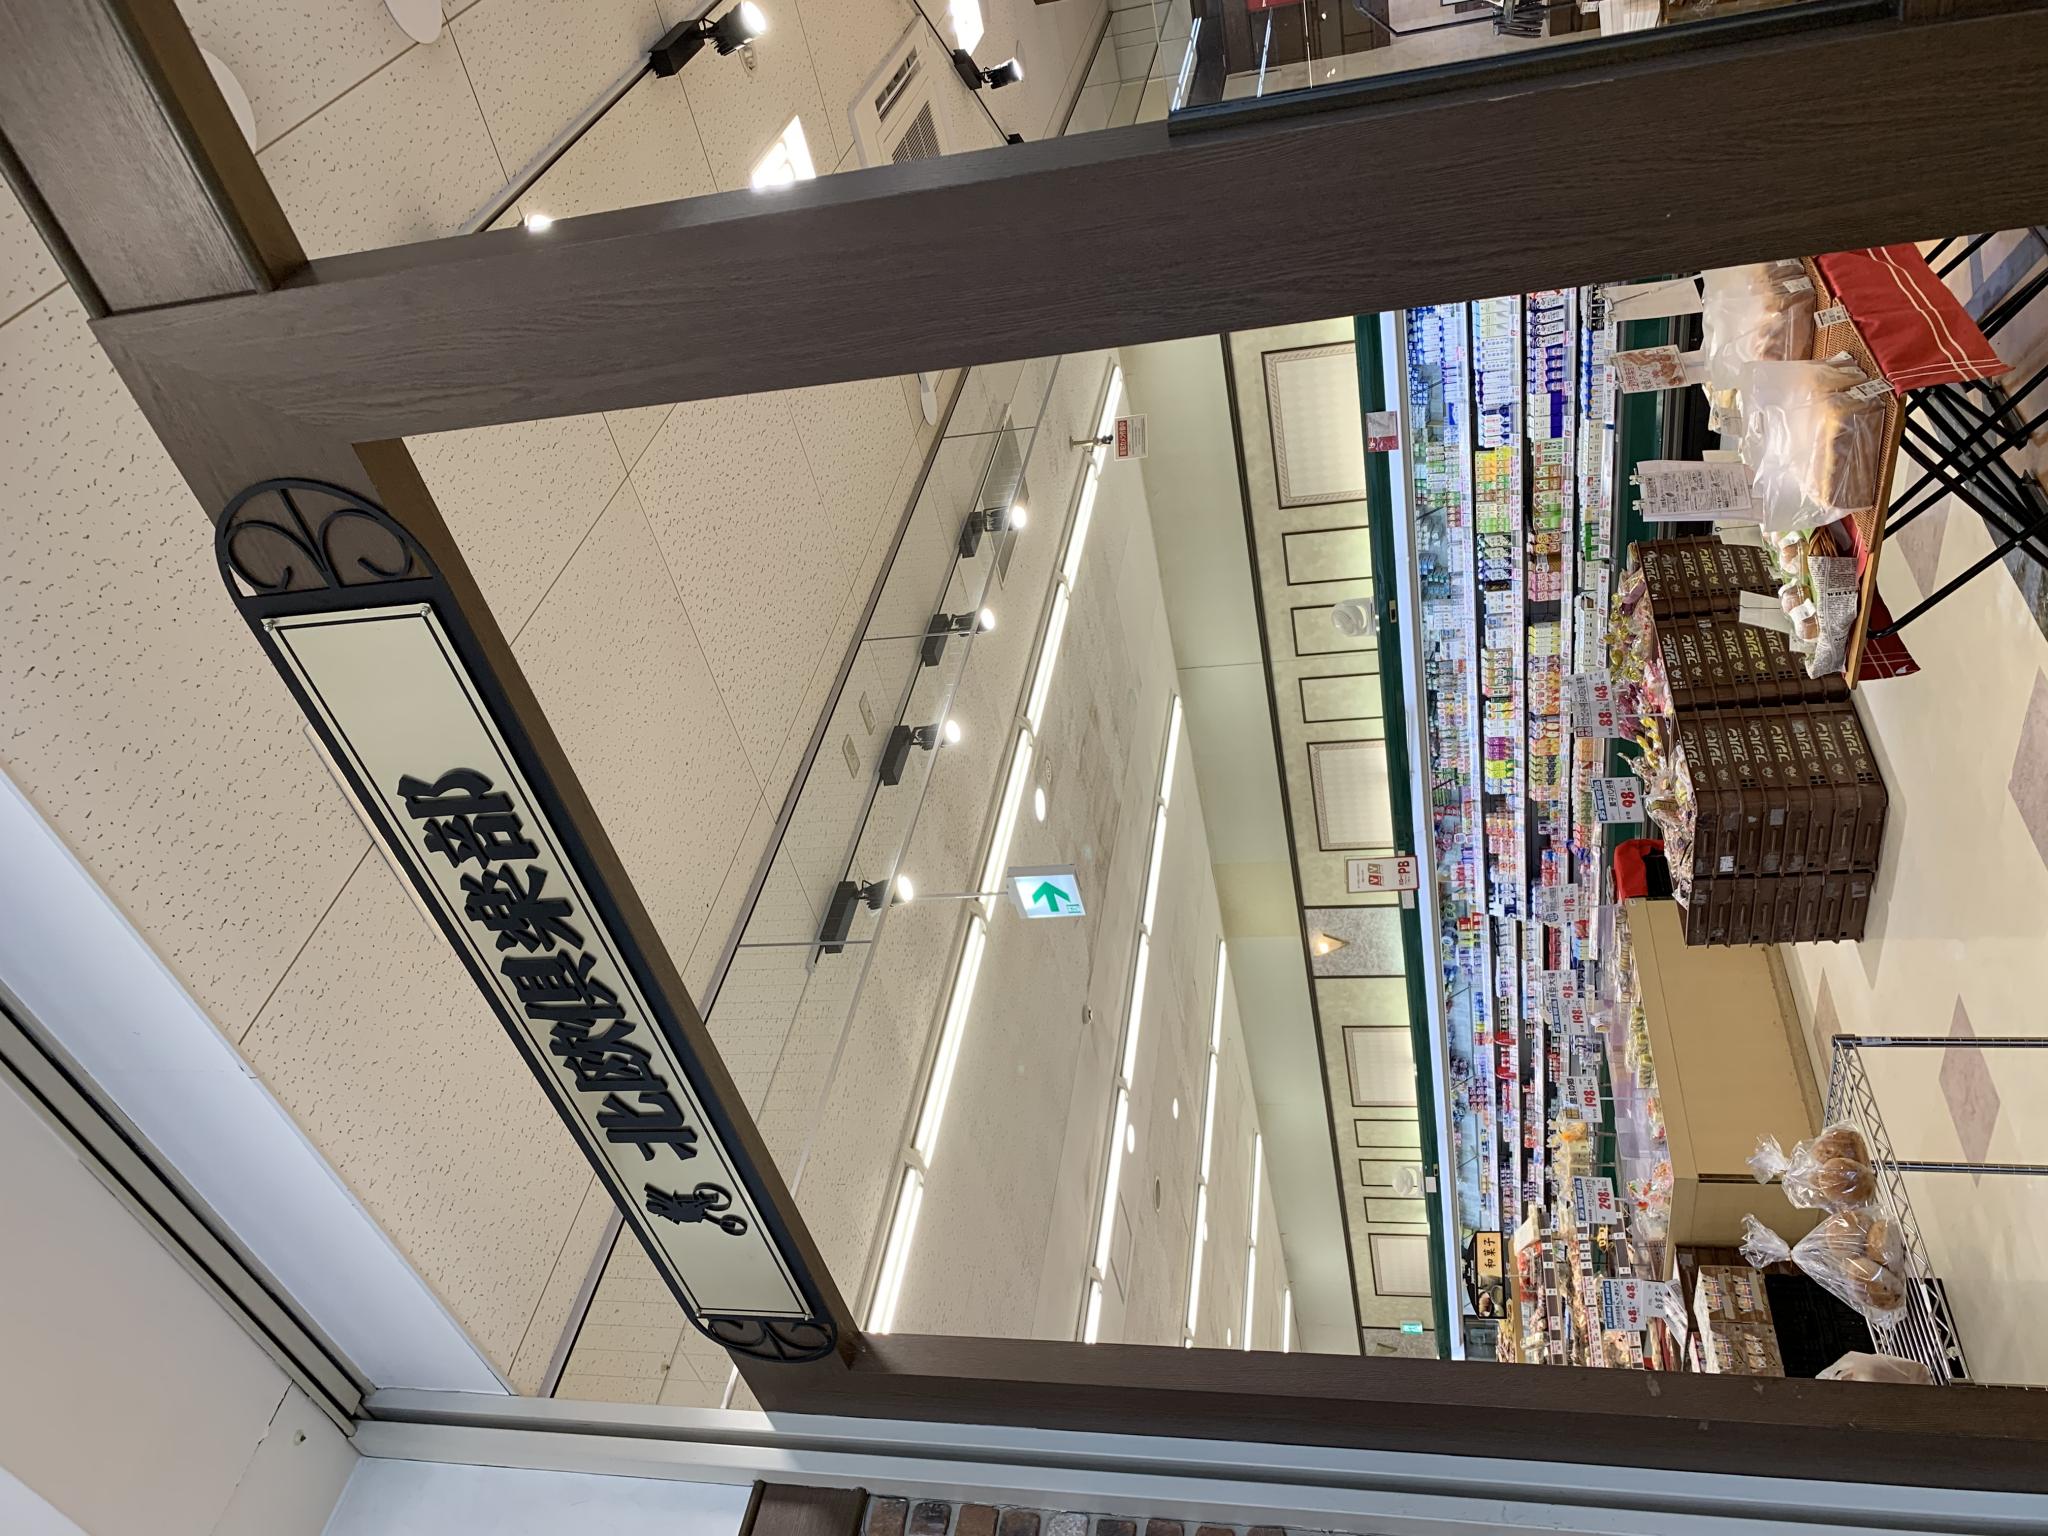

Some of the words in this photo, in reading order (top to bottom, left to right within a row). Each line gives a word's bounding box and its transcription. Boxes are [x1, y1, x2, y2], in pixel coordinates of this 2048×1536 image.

[1757, 548, 1772, 572] フジパ
[1763, 628, 1781, 654] フジパ
[1594, 685, 1609, 701] 148
[1598, 712, 1613, 727] 88
[1682, 730, 1701, 768] フジパン
[1704, 729, 1723, 766] フジパン
[1727, 728, 1745, 762] フジパン
[1748, 724, 1768, 763] フジパン
[1770, 725, 1791, 762] フジパン
[1795, 731, 1814, 759] フジパ
[1816, 722, 1837, 760] フジパン
[1840, 720, 1861, 756] フジパン
[1621, 791, 1637, 808] 98
[397, 767, 698, 1162] 北欧倶楽部
[1573, 1009, 1585, 1024] 198
[1584, 1089, 1597, 1107] 198
[1598, 1191, 1611, 1209] 298
[1484, 1237, 1497, 1269] 和菓子
[1625, 1284, 1637, 1300] 48
[1627, 1309, 1638, 1324] 48
